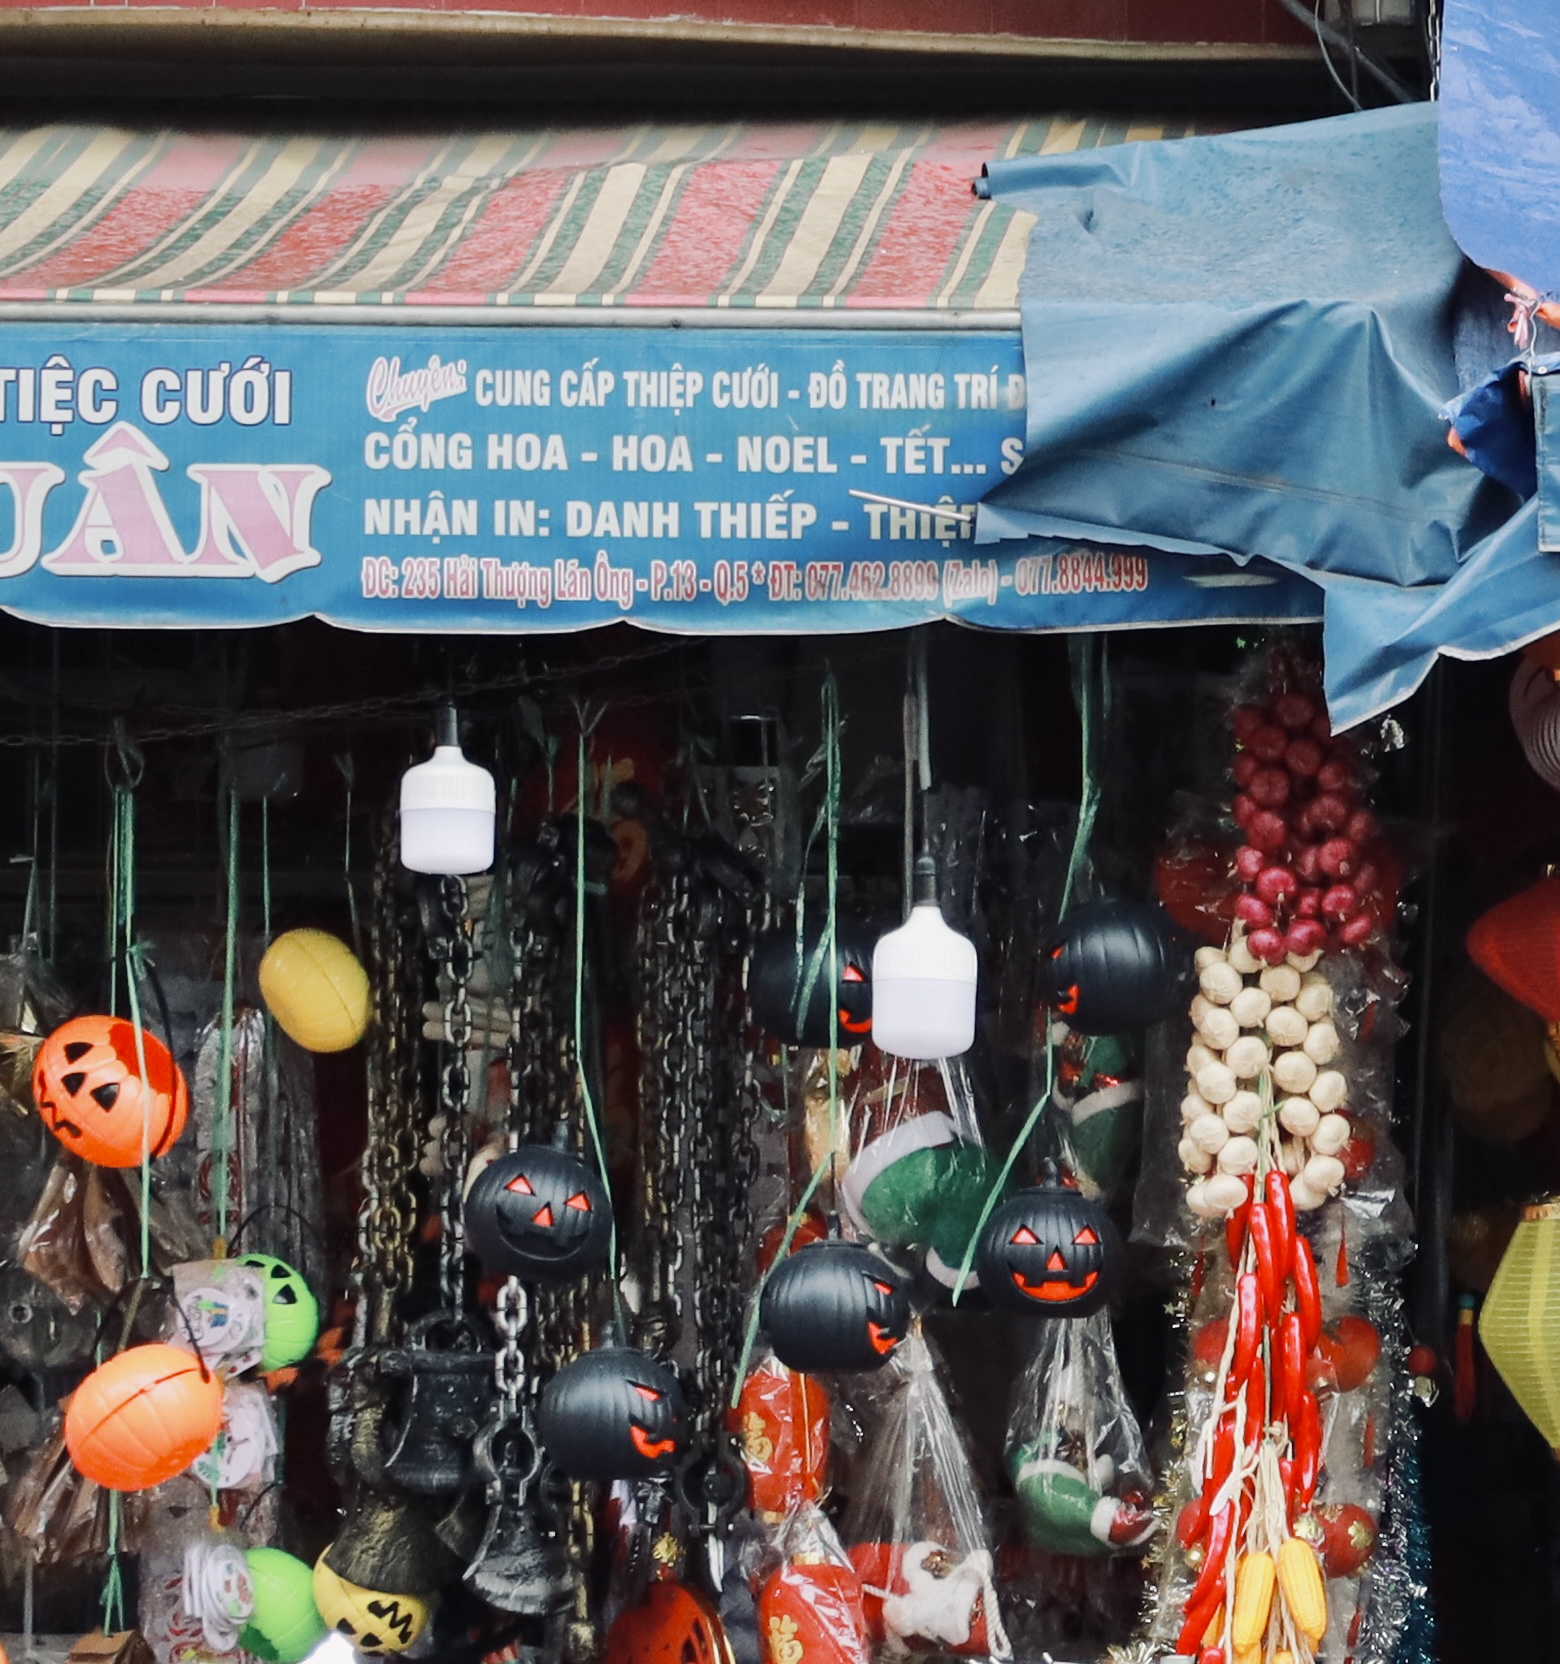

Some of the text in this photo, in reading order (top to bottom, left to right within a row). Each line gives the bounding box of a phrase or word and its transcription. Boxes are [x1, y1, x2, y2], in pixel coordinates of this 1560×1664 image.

[141, 356, 291, 426] CƯỚI
[475, 369, 552, 407] CUNG
[559, 357, 615, 408] CẤP
[622, 363, 703, 416] THIỆP
[711, 363, 779, 409] CƯỚI
[808, 359, 847, 409] ĐỒ
[856, 373, 945, 410] TRANG
[954, 365, 998, 410] TRÍ
[364, 416, 474, 471] CỔNG
[486, 434, 569, 471] HOA
[611, 434, 694, 473] HOA
[737, 436, 838, 474] NOEL
[880, 424, 987, 475] TẾT...
[364, 490, 478, 545] NHẬN
[493, 499, 551, 537] IN:
[566, 500, 680, 539] DANH
[694, 489, 818, 539] THIẾP
[361, 555, 400, 600] ĐC:
[401, 557, 440, 600] 235
[444, 553, 478, 600] Hải
[480, 558, 552, 609] Thượng
[554, 558, 591, 601] Lãn
[594, 548, 634, 611] Ông
[650, 559, 697, 602] P.13
[712, 559, 749, 607] Q.5
[768, 561, 803, 602] ĐT:
[807, 558, 940, 603] 077.462.8899
[944, 558, 1000, 608] (Zalo)
[1015, 550, 1149, 597] 077.8844.999
